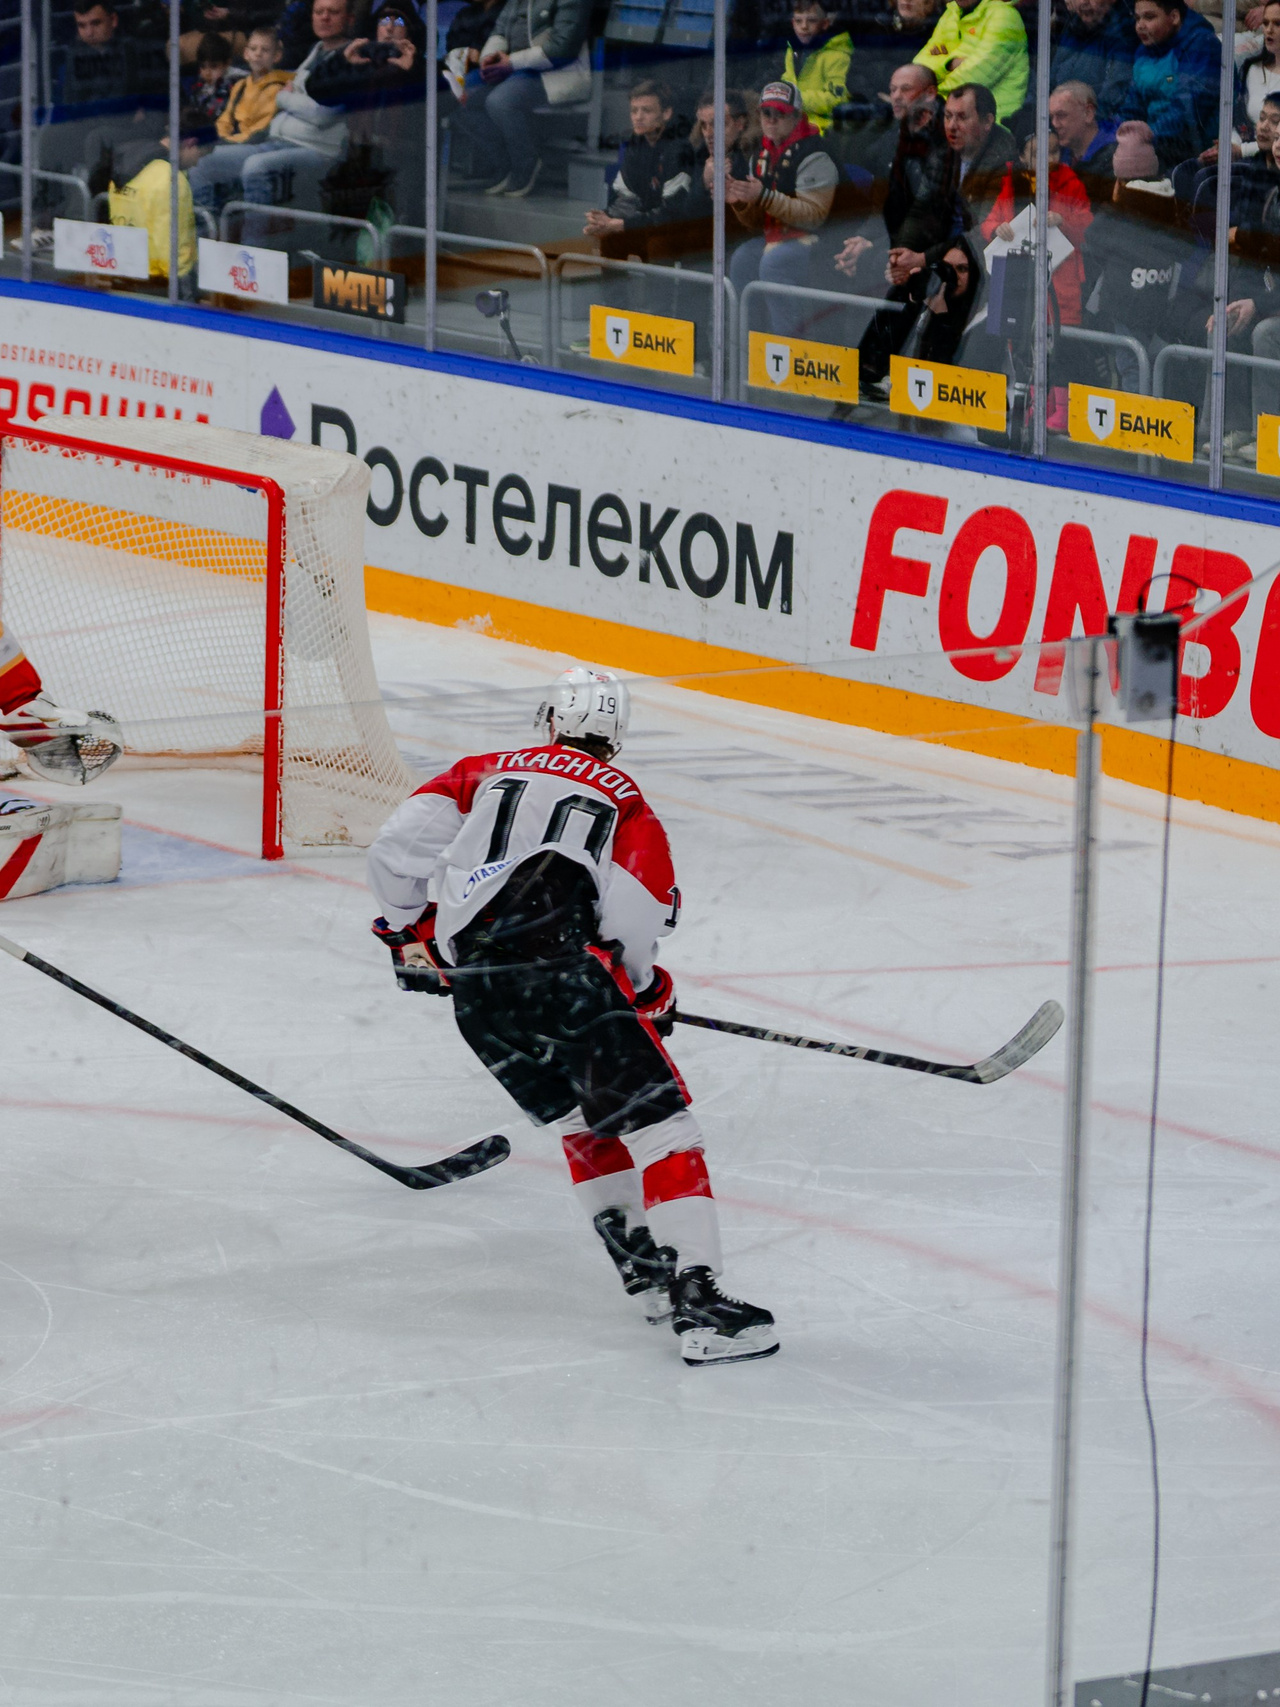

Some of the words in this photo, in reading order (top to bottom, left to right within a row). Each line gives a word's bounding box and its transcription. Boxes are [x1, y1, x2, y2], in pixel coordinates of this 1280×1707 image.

[633, 331, 677, 355] БАНК
[110, 361, 214, 397] #UNITEDWEWIN
[793, 357, 840, 383] БАНК
[937, 384, 987, 409] БАНК
[1119, 413, 1173, 440] БАНК
[597, 695, 616, 714] 19
[496, 752, 639, 800] TKACHYOV
